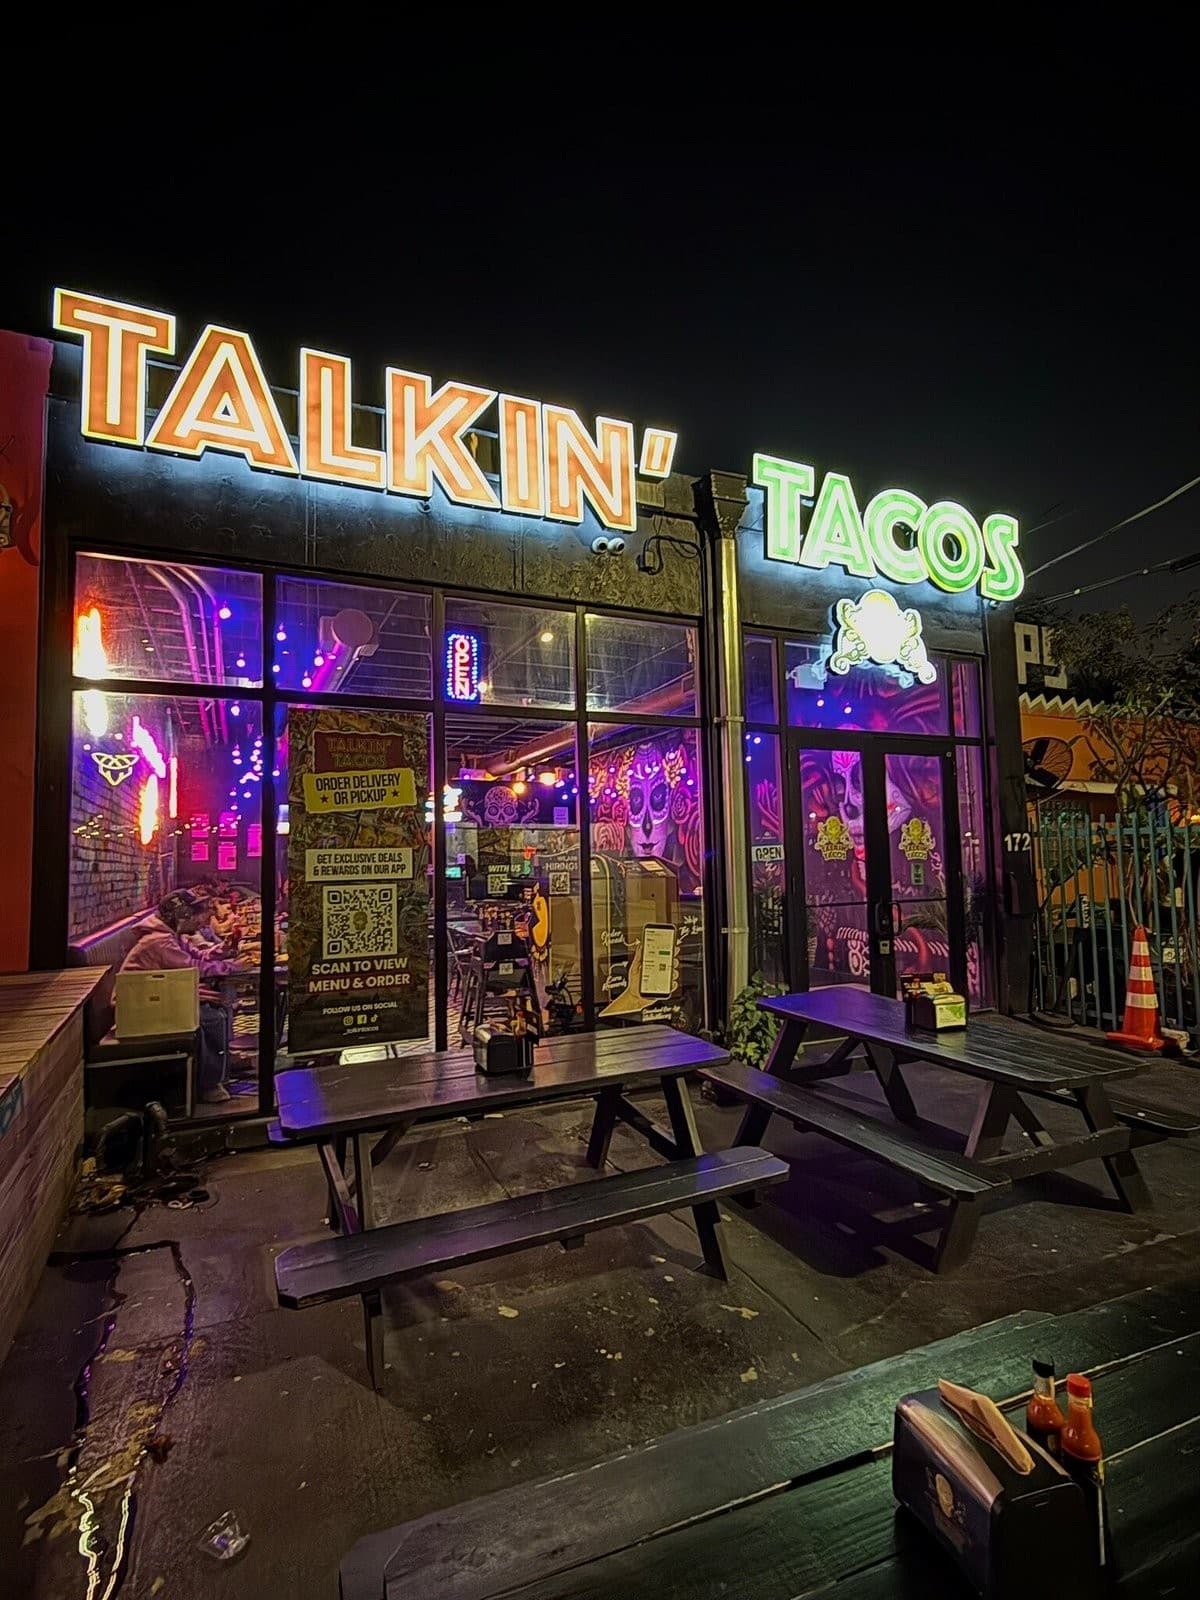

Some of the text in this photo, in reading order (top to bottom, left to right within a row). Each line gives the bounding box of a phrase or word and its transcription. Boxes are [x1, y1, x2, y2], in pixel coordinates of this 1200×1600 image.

[54, 287, 677, 532] TALKIN'
[752, 453, 1025, 601] TACOS
[454, 638, 470, 697] OPEN
[331, 752, 387, 768] TACOS
[315, 773, 401, 792] ORDER DELIVERY
[333, 788, 387, 805] OR PICKUP
[1004, 833, 1031, 851] 172
[317, 852, 402, 864] GET EXCLUSIVE DEALS
[755, 846, 782, 860] OPEN
[320, 864, 360, 876] REWARDS
[361, 864, 373, 875] ON
[374, 864, 390, 874] OUR
[391, 862, 407, 874] APP
[488, 864, 521, 873] WITH US
[311, 957, 408, 975] SCAN TO VIEW
[309, 973, 411, 993] MENU & ORDER
[322, 1001, 398, 1015] FOLLOW US ON SOCIAL
